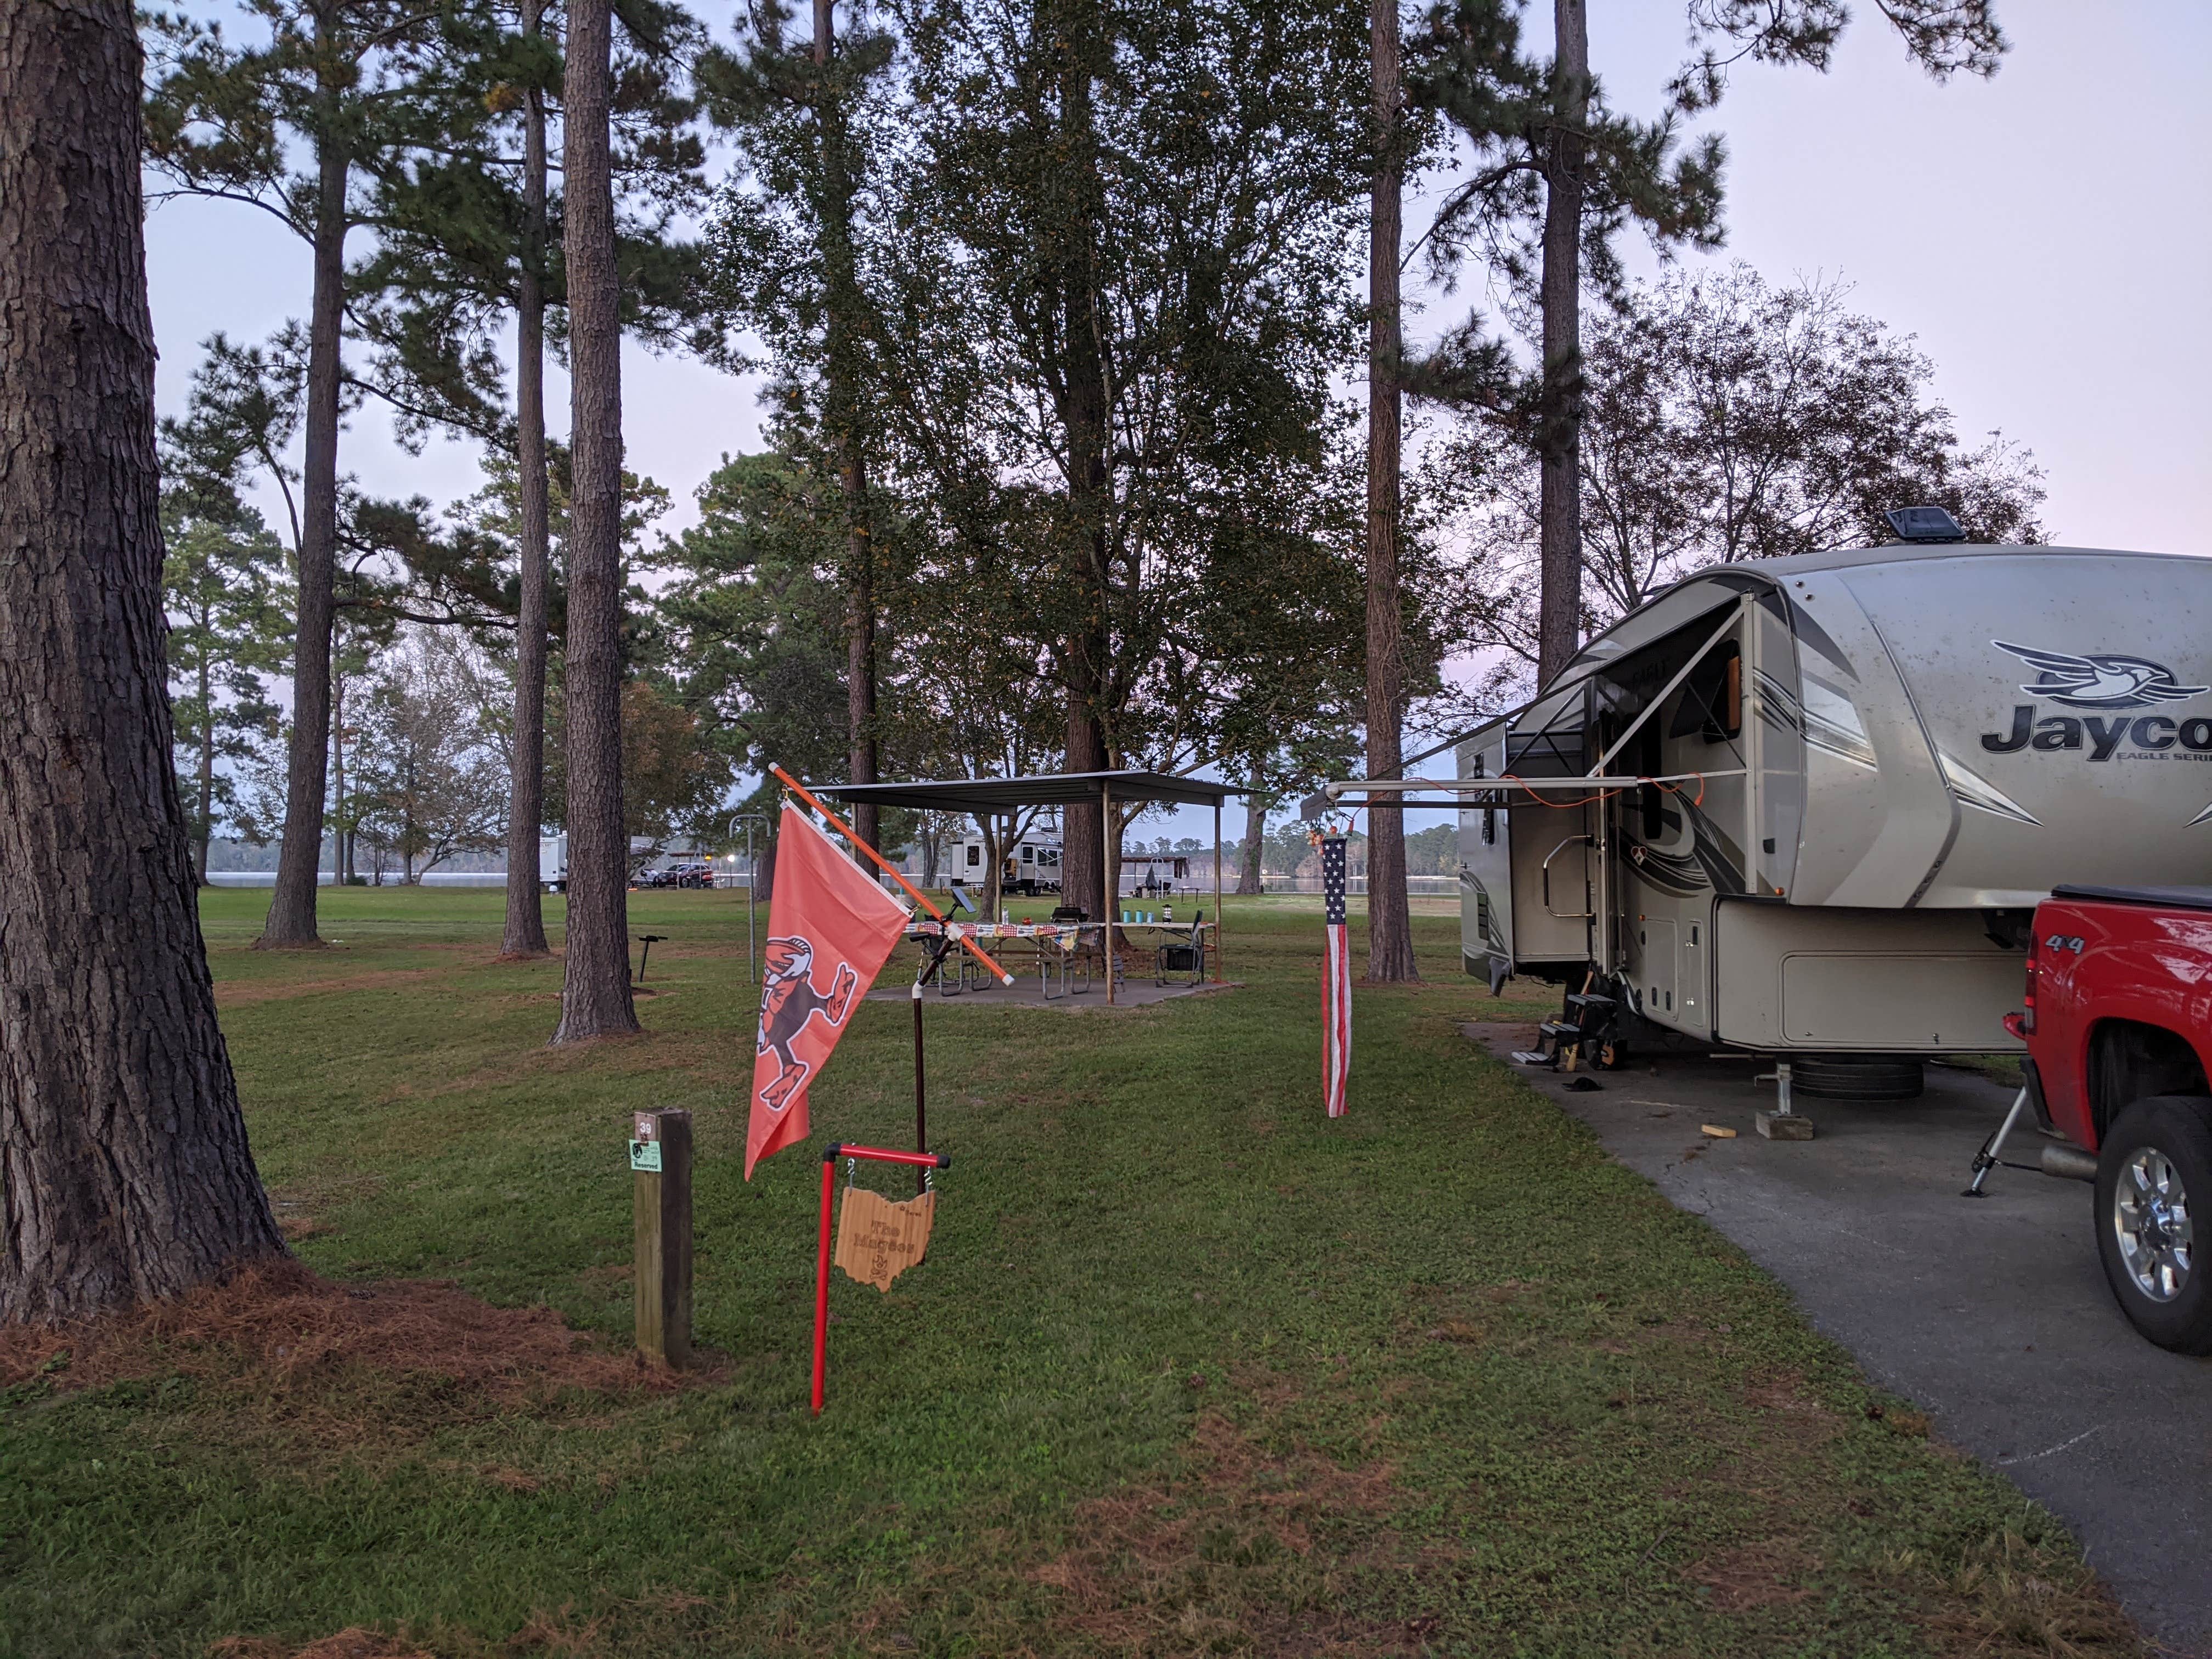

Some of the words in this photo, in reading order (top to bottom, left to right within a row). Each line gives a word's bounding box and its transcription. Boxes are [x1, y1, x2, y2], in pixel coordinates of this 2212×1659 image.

[1979, 704, 2212, 761] Jayco
[2173, 753, 2212, 761] SERI
[640, 1122, 651, 1134] 39
